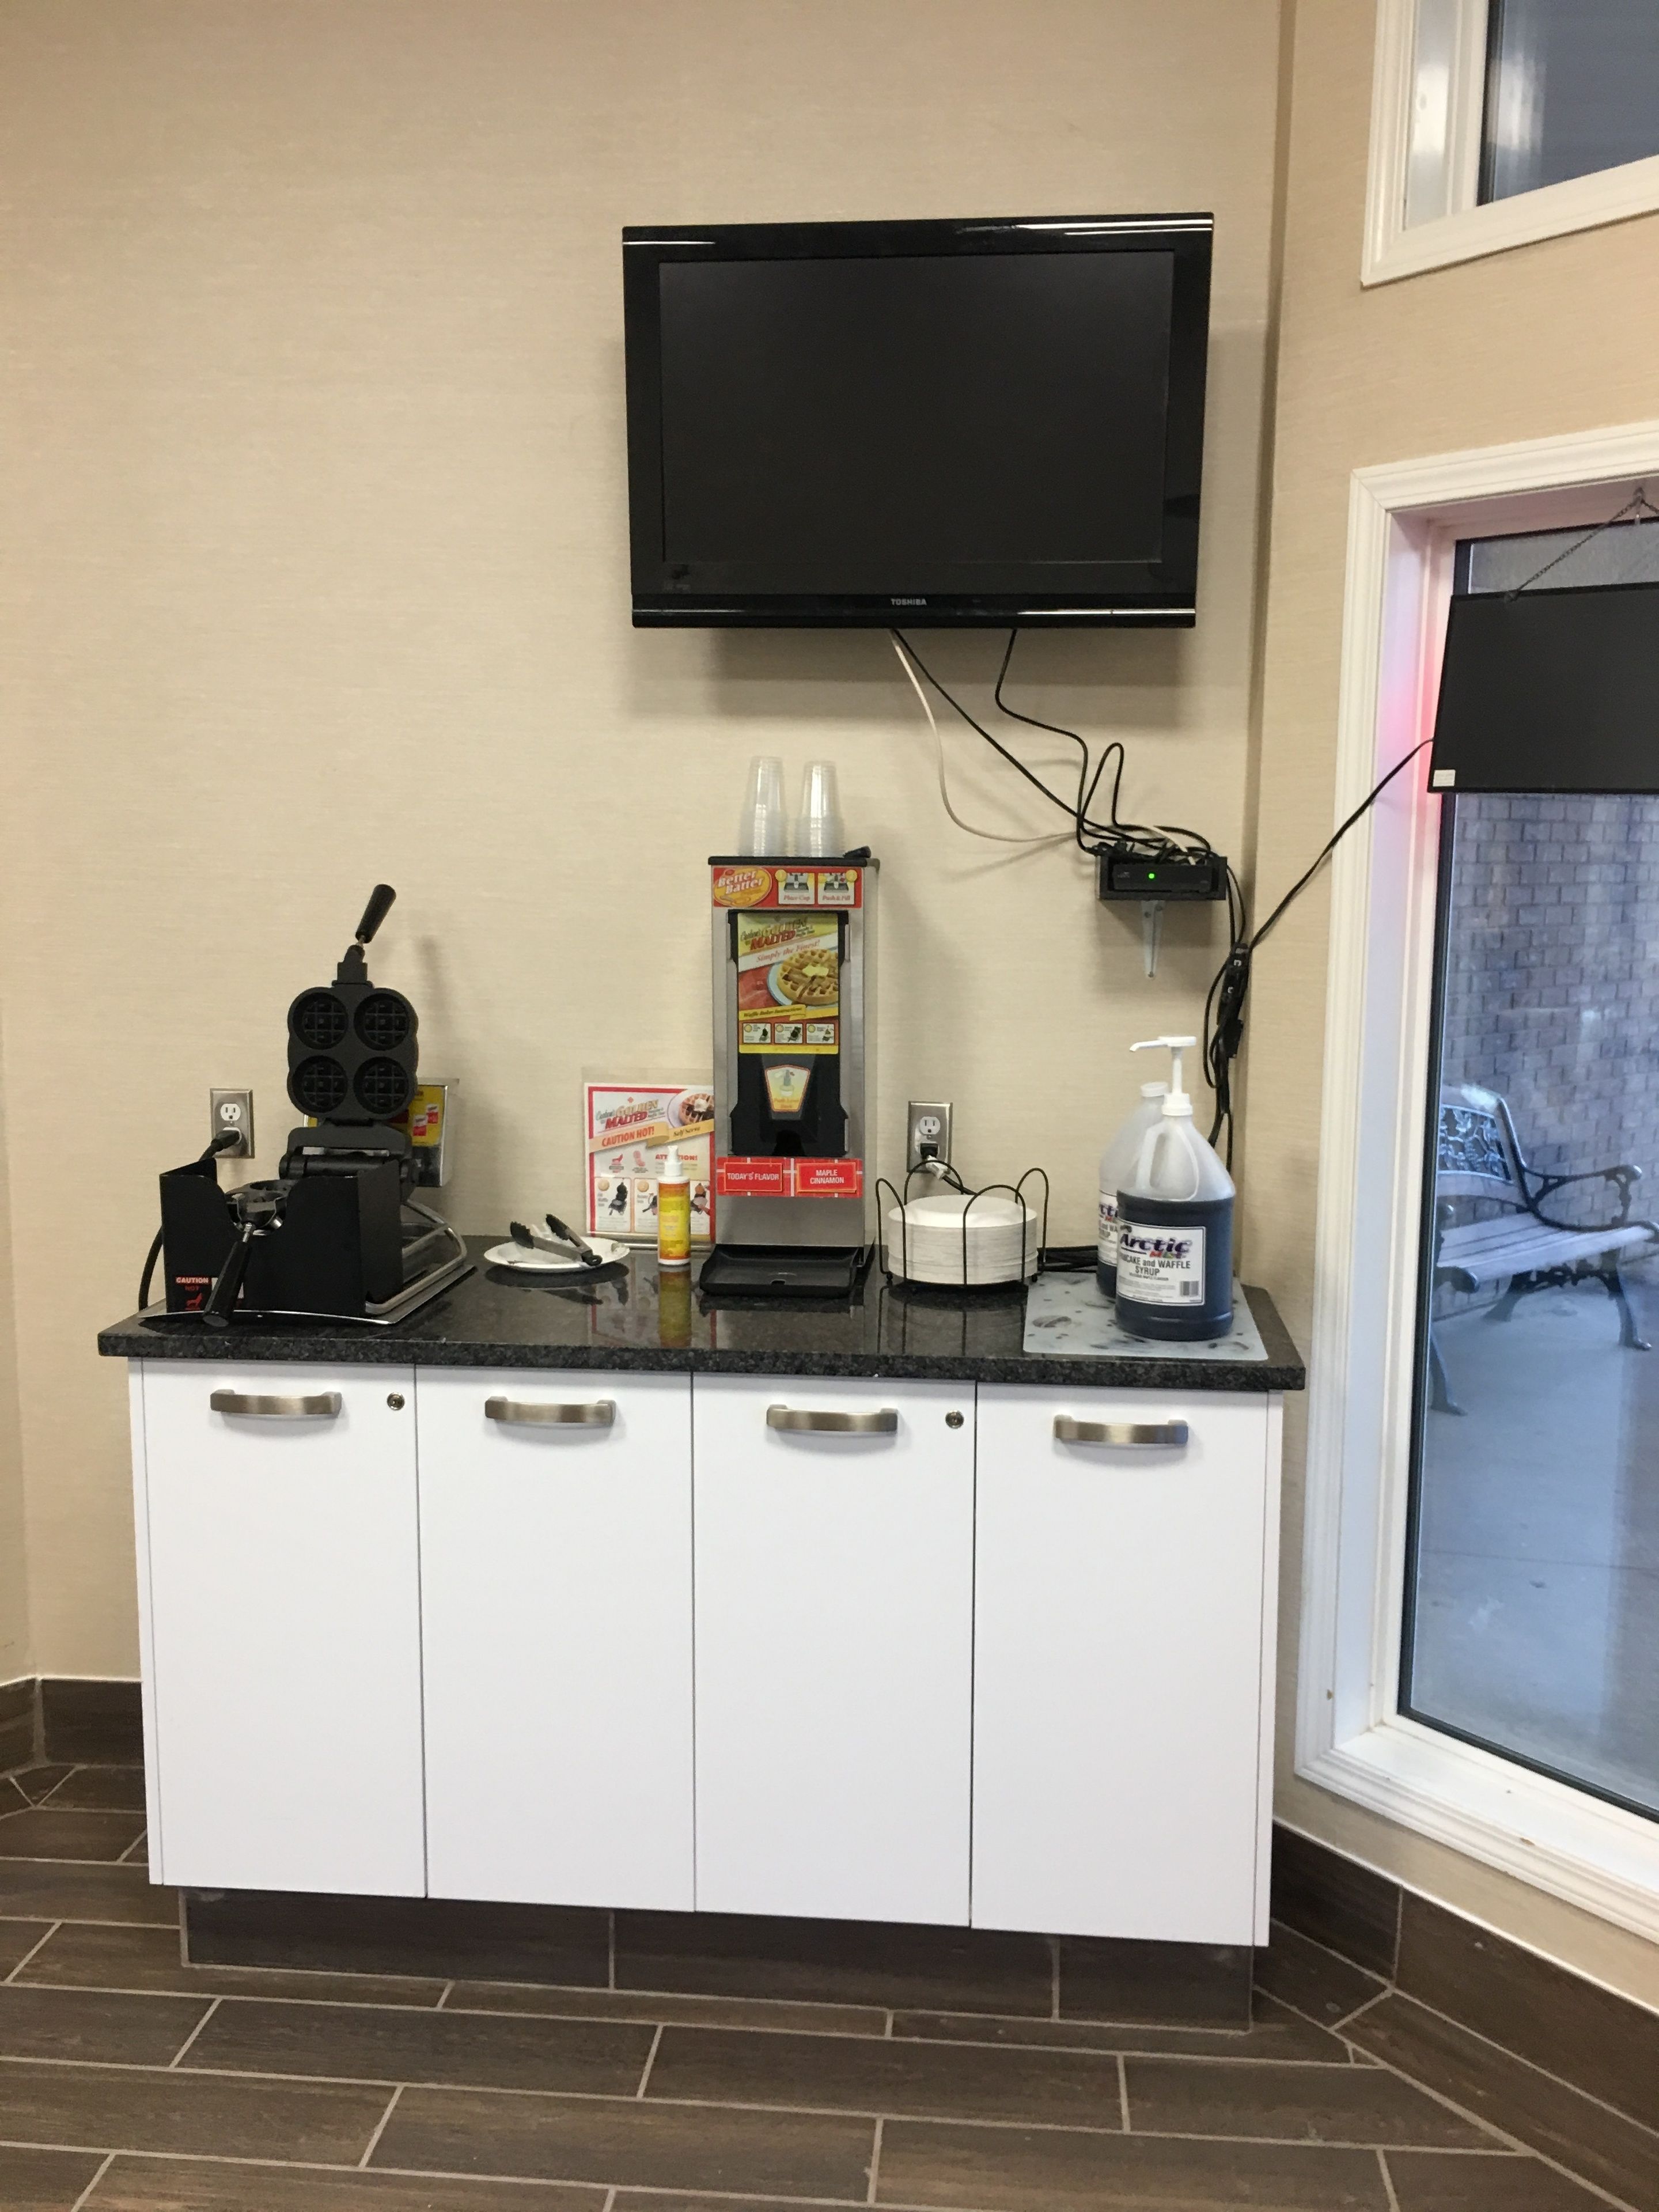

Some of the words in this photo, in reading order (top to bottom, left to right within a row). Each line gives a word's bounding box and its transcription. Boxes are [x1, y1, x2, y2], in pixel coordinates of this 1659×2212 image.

[718, 870, 757, 887] Better
[726, 878, 763, 894] Batter
[751, 929, 796, 950] MALTED
[756, 950, 781, 963] Simply
[605, 1111, 647, 1129] MALTED
[602, 1131, 635, 1147] CAUTION
[637, 1126, 654, 1138] HOT!
[1120, 1233, 1192, 1253] Arctic
[1135, 1265, 1160, 1276] SYRUP
[1157, 1260, 1191, 1269] WAFFLE
